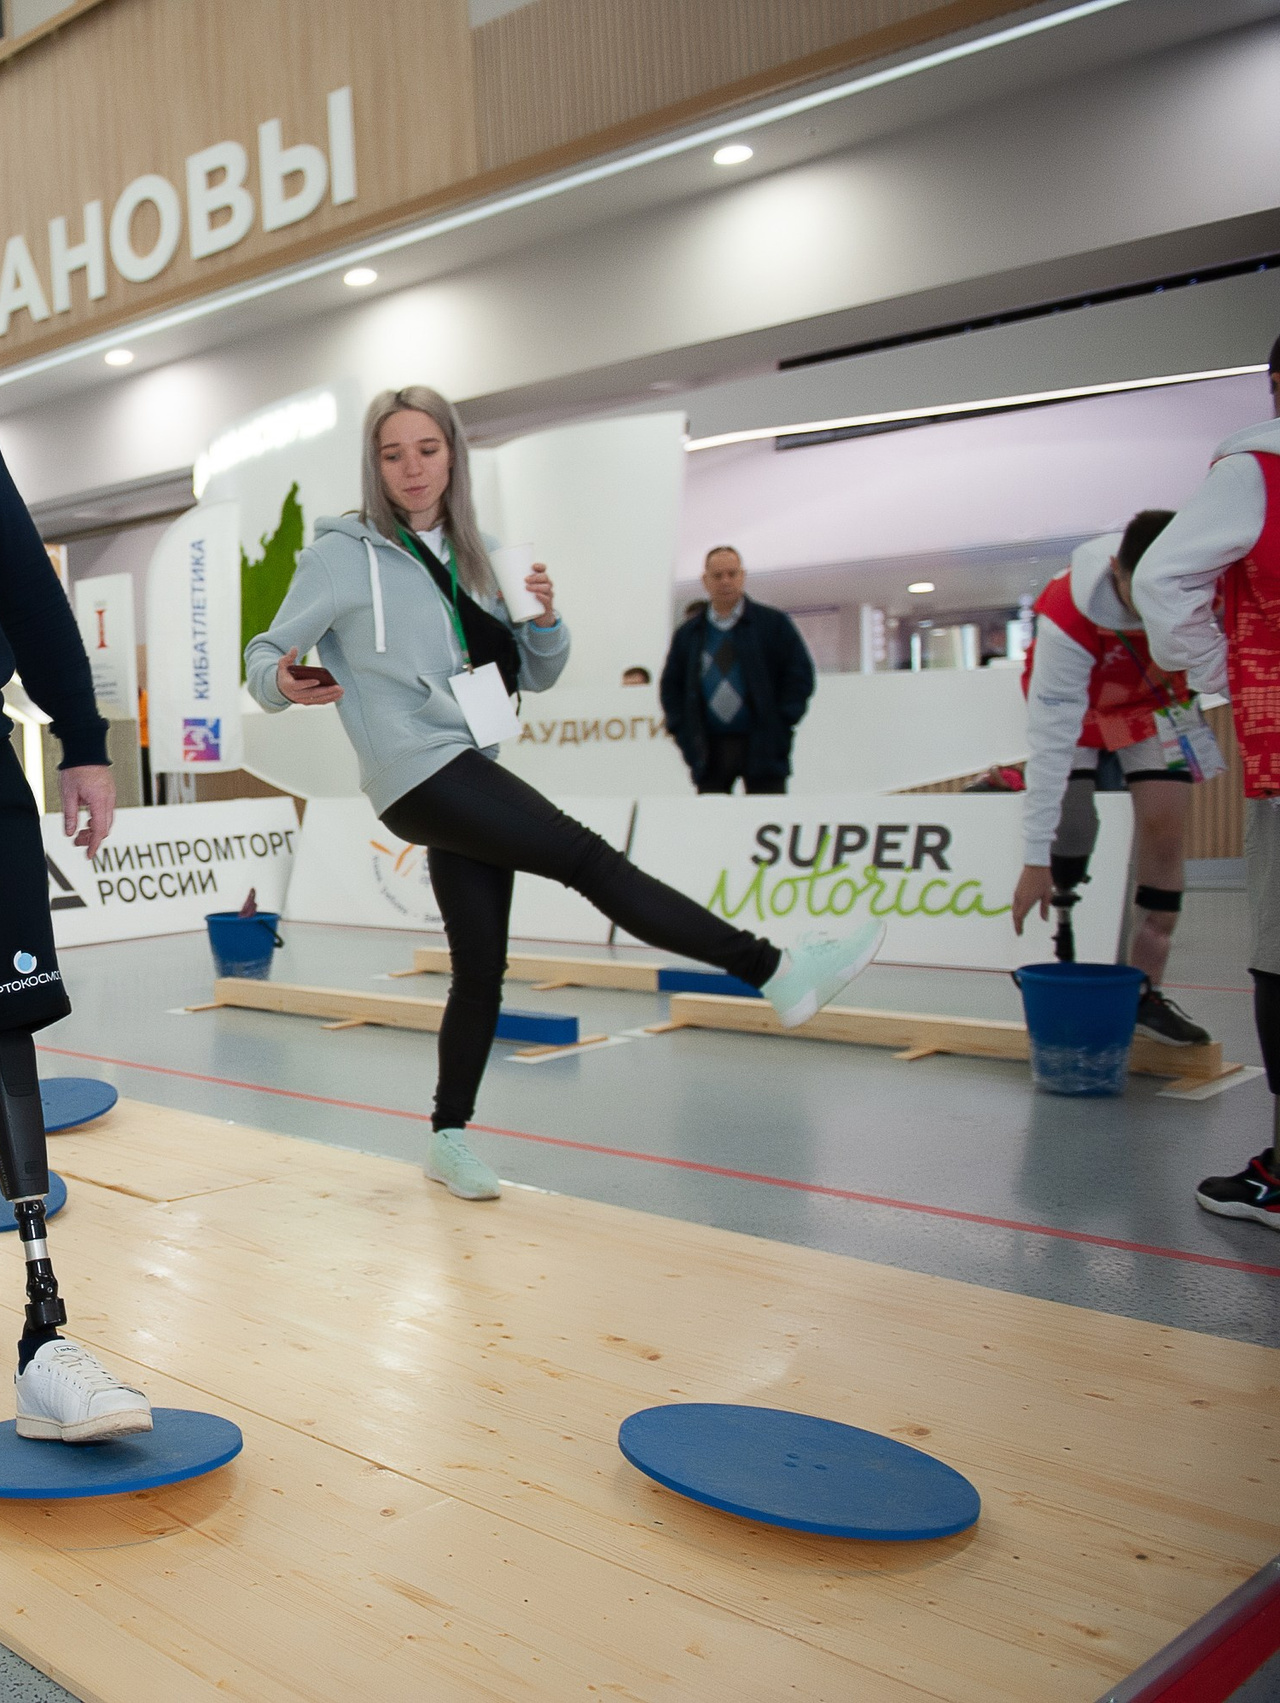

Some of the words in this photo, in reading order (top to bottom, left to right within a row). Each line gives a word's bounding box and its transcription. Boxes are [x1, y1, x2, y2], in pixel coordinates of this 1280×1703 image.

[190, 538, 209, 700] КИБАТЛЕТИКА
[91, 830, 294, 874] МИНПРОМТОРГ
[751, 824, 952, 871] SUPER
[97, 869, 218, 905] РОССИИ
[706, 834, 1012, 922] Motorica
